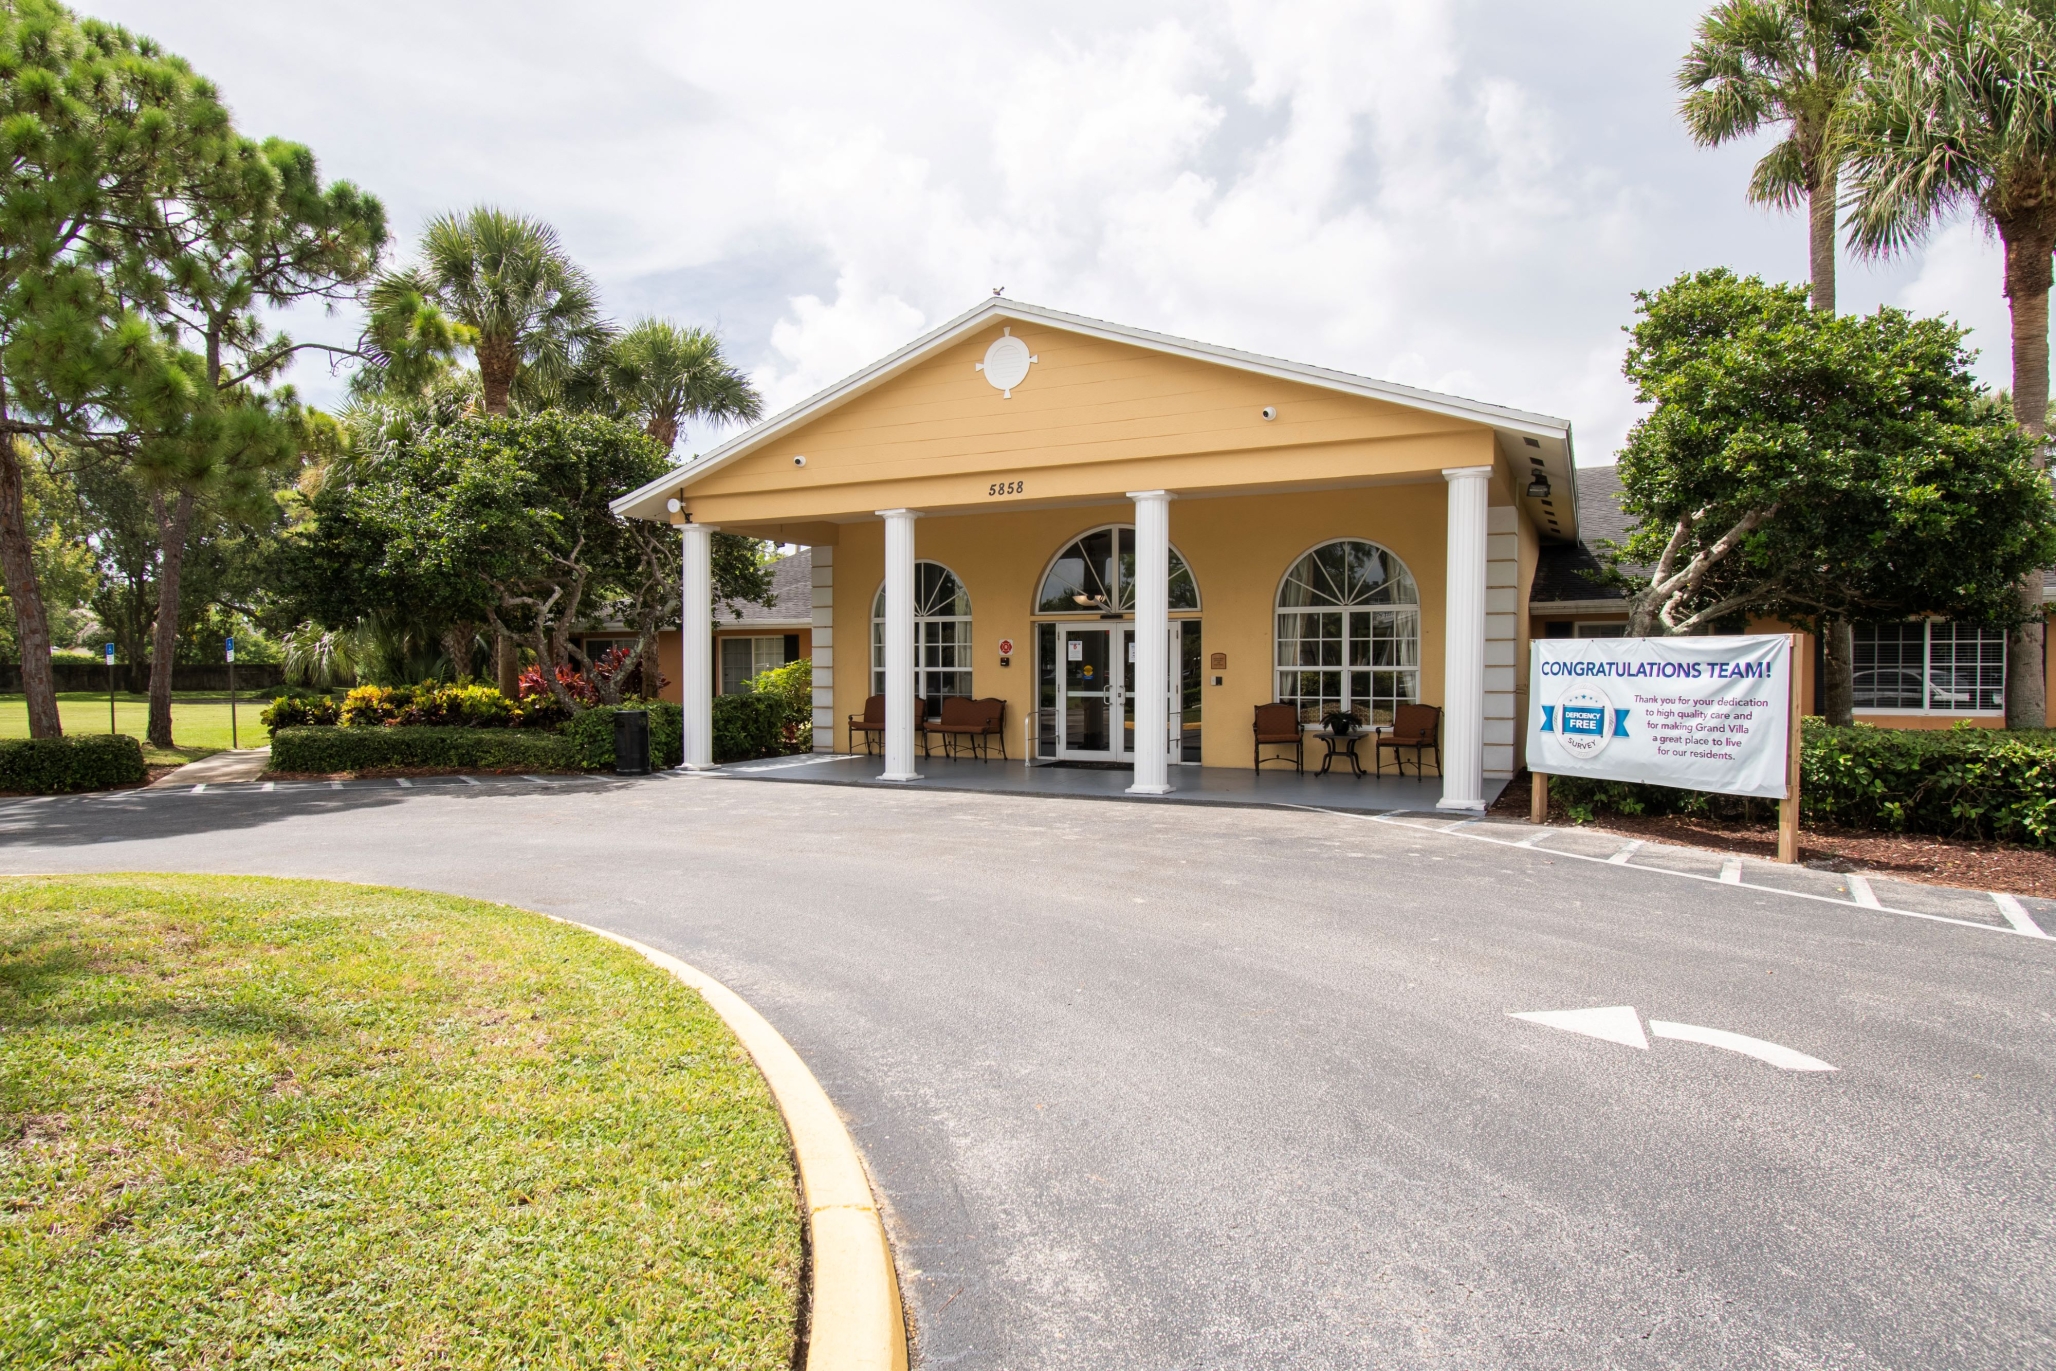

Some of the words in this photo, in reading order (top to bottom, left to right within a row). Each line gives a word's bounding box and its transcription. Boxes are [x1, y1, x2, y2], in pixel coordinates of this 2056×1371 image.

[988, 480, 1024, 496] 5858
[1541, 661, 1702, 678] CONGRATULATIONS
[1706, 661, 1772, 679] TEAM!
[1634, 694, 1658, 704] Thank
[1660, 698, 1676, 706] you
[1678, 695, 1691, 705] for
[1692, 699, 1714, 708] your
[1717, 696, 1769, 707] dedication
[1565, 711, 1601, 720] DEFICIENCY
[1645, 709, 1655, 717] to
[1656, 708, 1675, 719] high
[1677, 709, 1709, 721] quality
[1710, 712, 1731, 720] care
[1733, 711, 1753, 720] and
[1569, 719, 1597, 730] FREE
[1647, 720, 1659, 729] for
[1660, 721, 1693, 734] making
[1695, 722, 1726, 733] Grand
[1728, 724, 1749, 734] Villa
[1567, 737, 1597, 750] SURVEY
[1659, 736, 1683, 745] great
[1684, 735, 1709, 746] place
[1712, 738, 1723, 746] to
[1725, 737, 1742, 747] live
[1657, 745, 1670, 755] for
[1672, 749, 1688, 757] our
[1689, 749, 1736, 761] residents.
